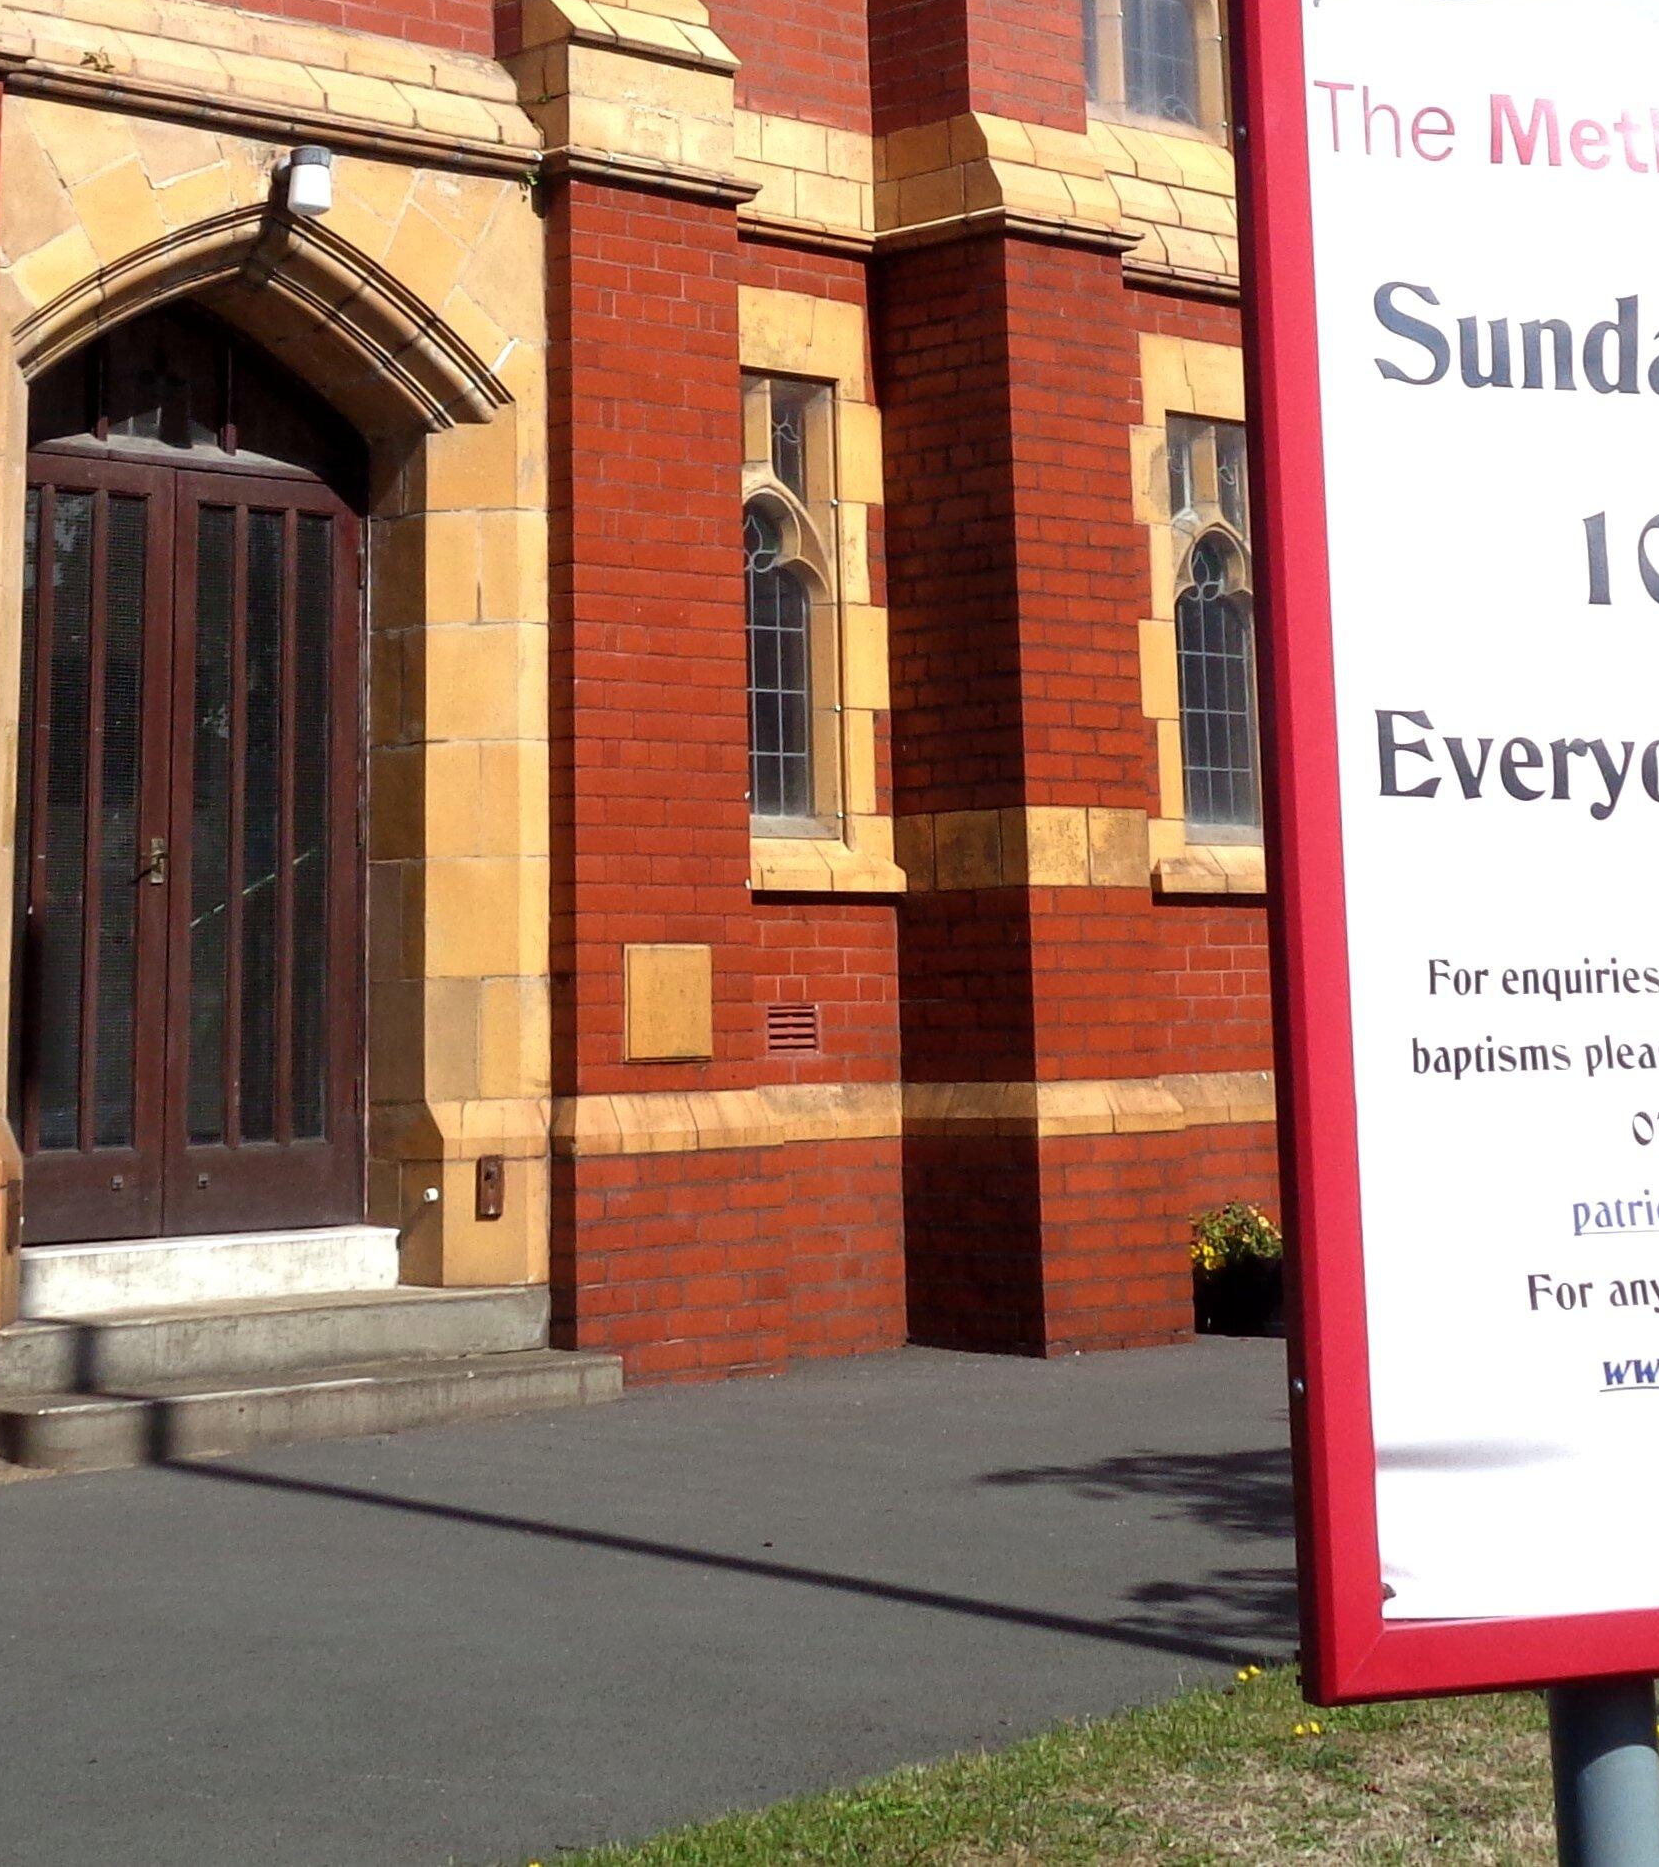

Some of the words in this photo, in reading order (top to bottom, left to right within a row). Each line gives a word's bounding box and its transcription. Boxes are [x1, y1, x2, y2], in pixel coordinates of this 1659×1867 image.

[1313, 81, 1455, 161] The
[1428, 959, 1490, 997] For
[1411, 1034, 1572, 1079] baptisms
[1527, 1272, 1593, 1311] For
